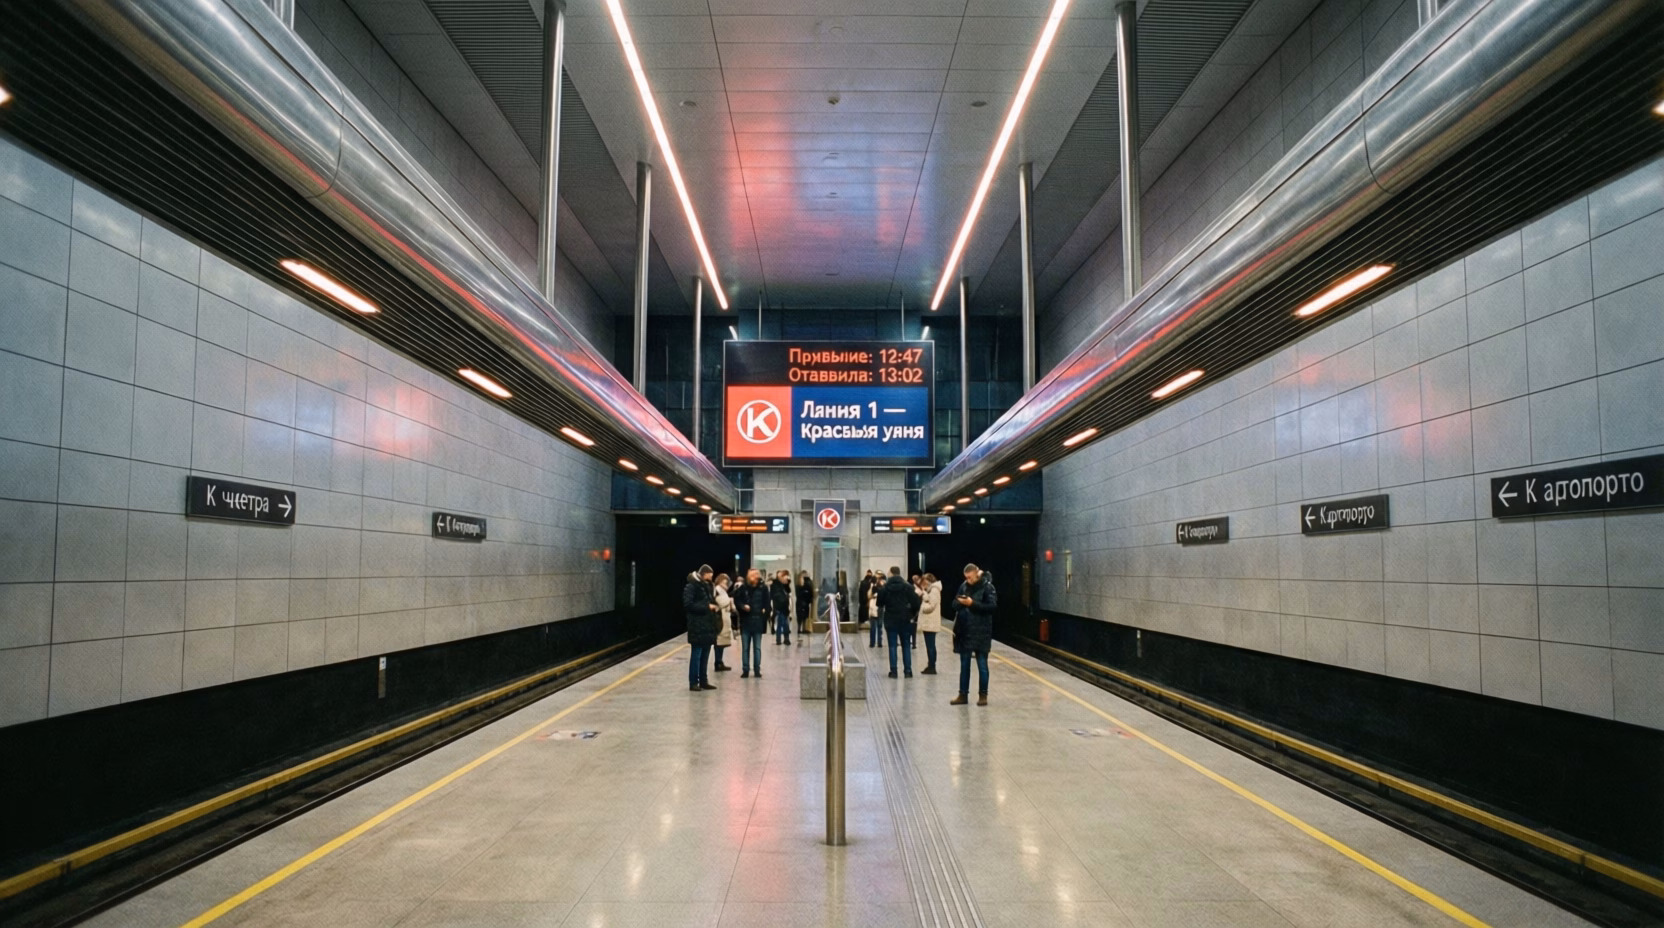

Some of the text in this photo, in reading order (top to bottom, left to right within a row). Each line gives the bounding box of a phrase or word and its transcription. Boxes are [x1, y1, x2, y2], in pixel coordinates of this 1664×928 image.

[879, 348, 924, 364] 12:47
[879, 367, 924, 383] 13:02
[868, 401, 877, 419] 1
[206, 484, 217, 507] К
[1525, 478, 1538, 504] К
